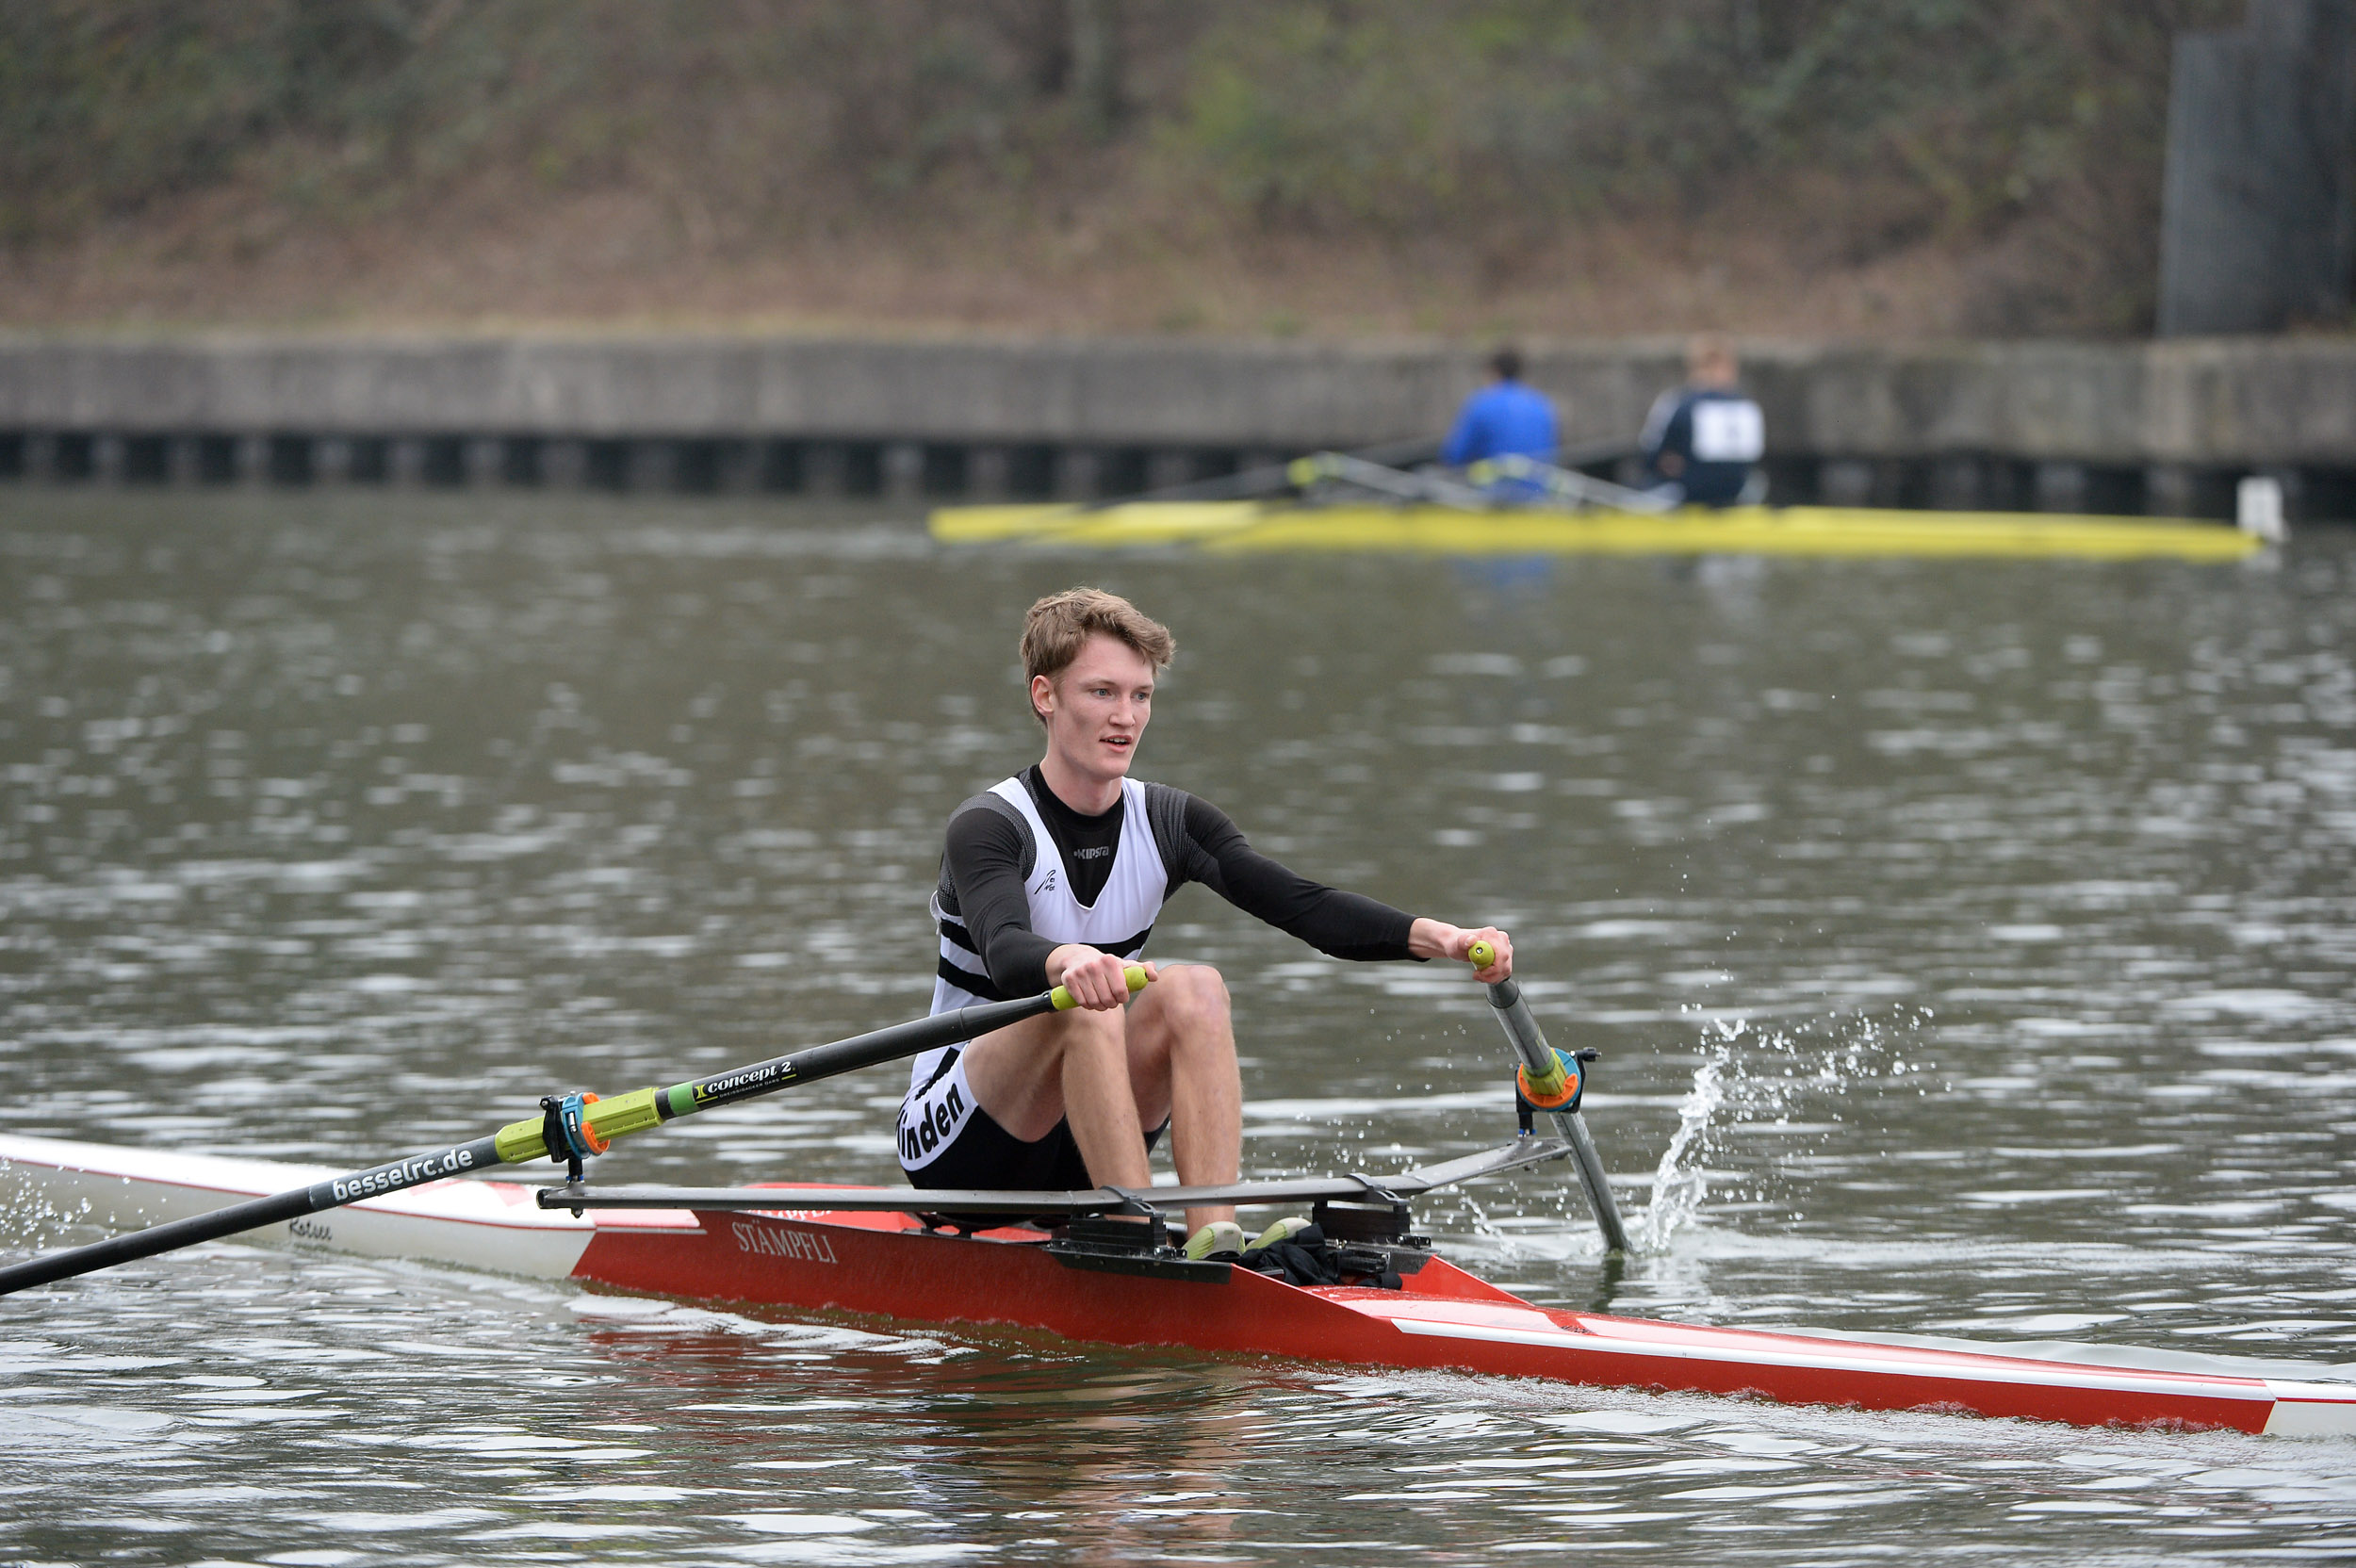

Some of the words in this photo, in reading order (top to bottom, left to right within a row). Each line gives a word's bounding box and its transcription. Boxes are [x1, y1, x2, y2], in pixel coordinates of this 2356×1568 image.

[708, 1065, 777, 1094] concept
[333, 1149, 473, 1201] besselrc.de
[732, 1219, 839, 1264] STÄMPFLI
